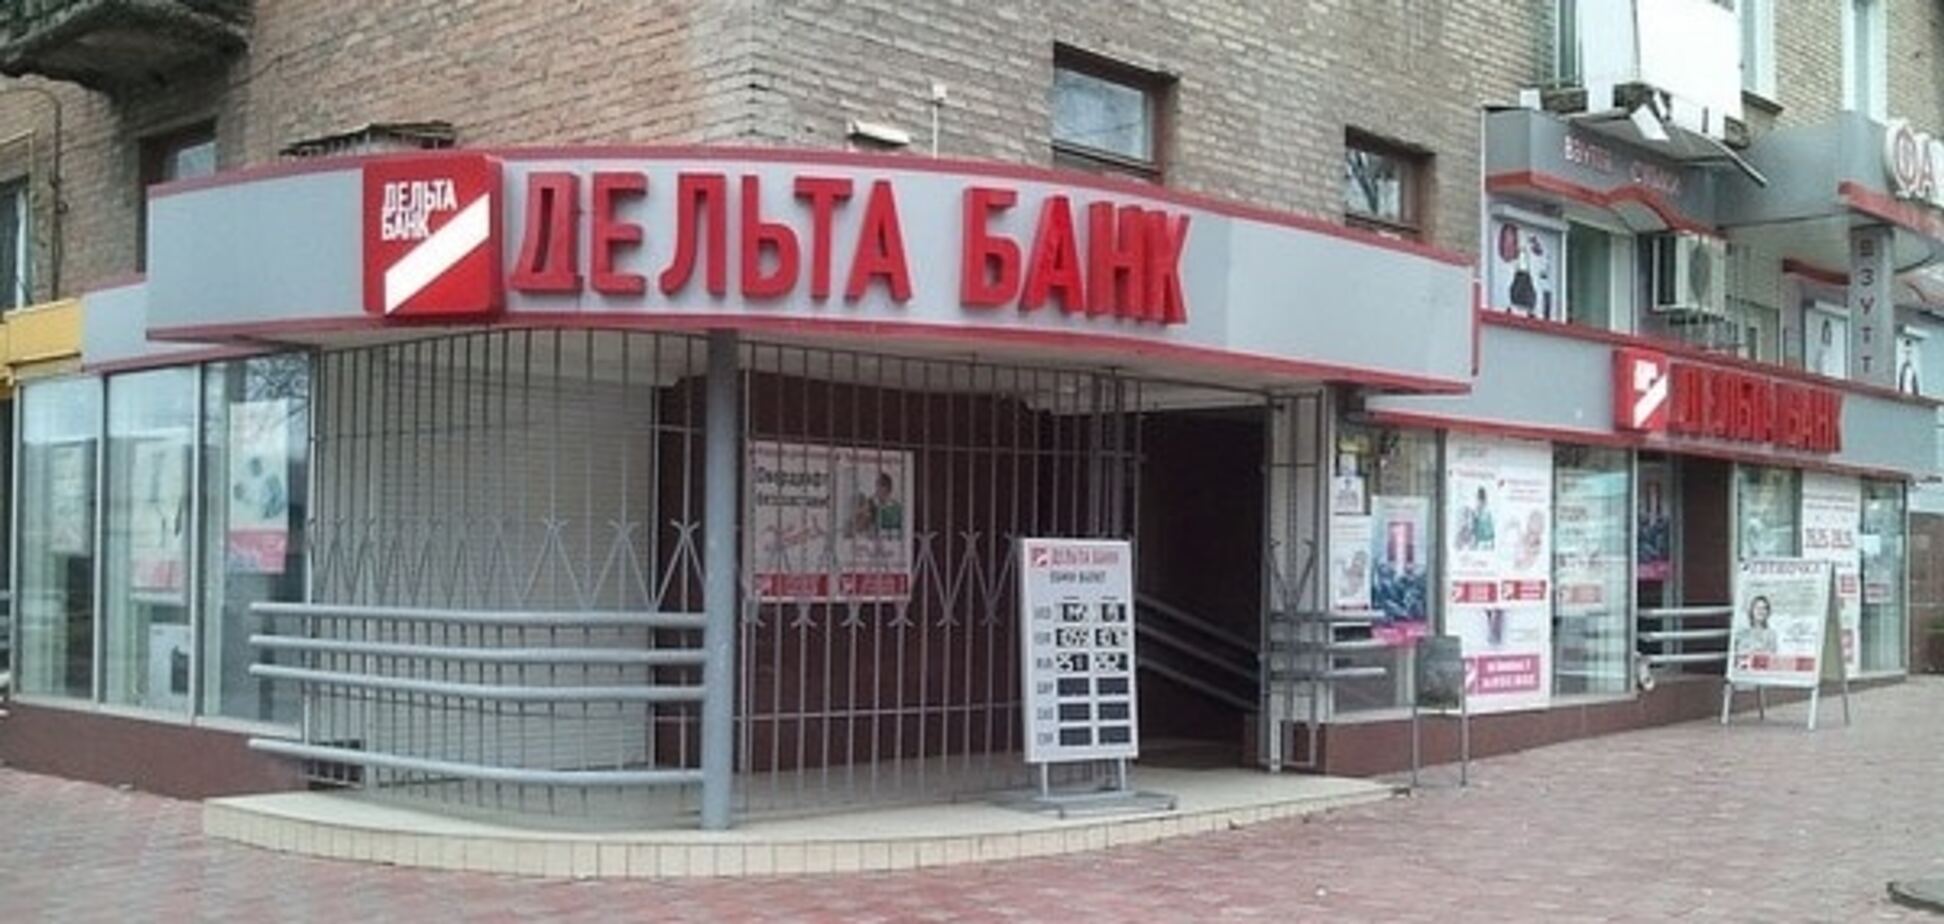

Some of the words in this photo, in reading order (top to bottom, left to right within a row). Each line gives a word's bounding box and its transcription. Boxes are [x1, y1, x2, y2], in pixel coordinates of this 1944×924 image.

[382, 179, 458, 212] ДЕЛЬТА
[381, 209, 429, 240] БАНК
[509, 171, 912, 303] ДЕЛЬТА
[959, 187, 1190, 325] БАНК
[1775, 382, 1842, 453] БАНК
